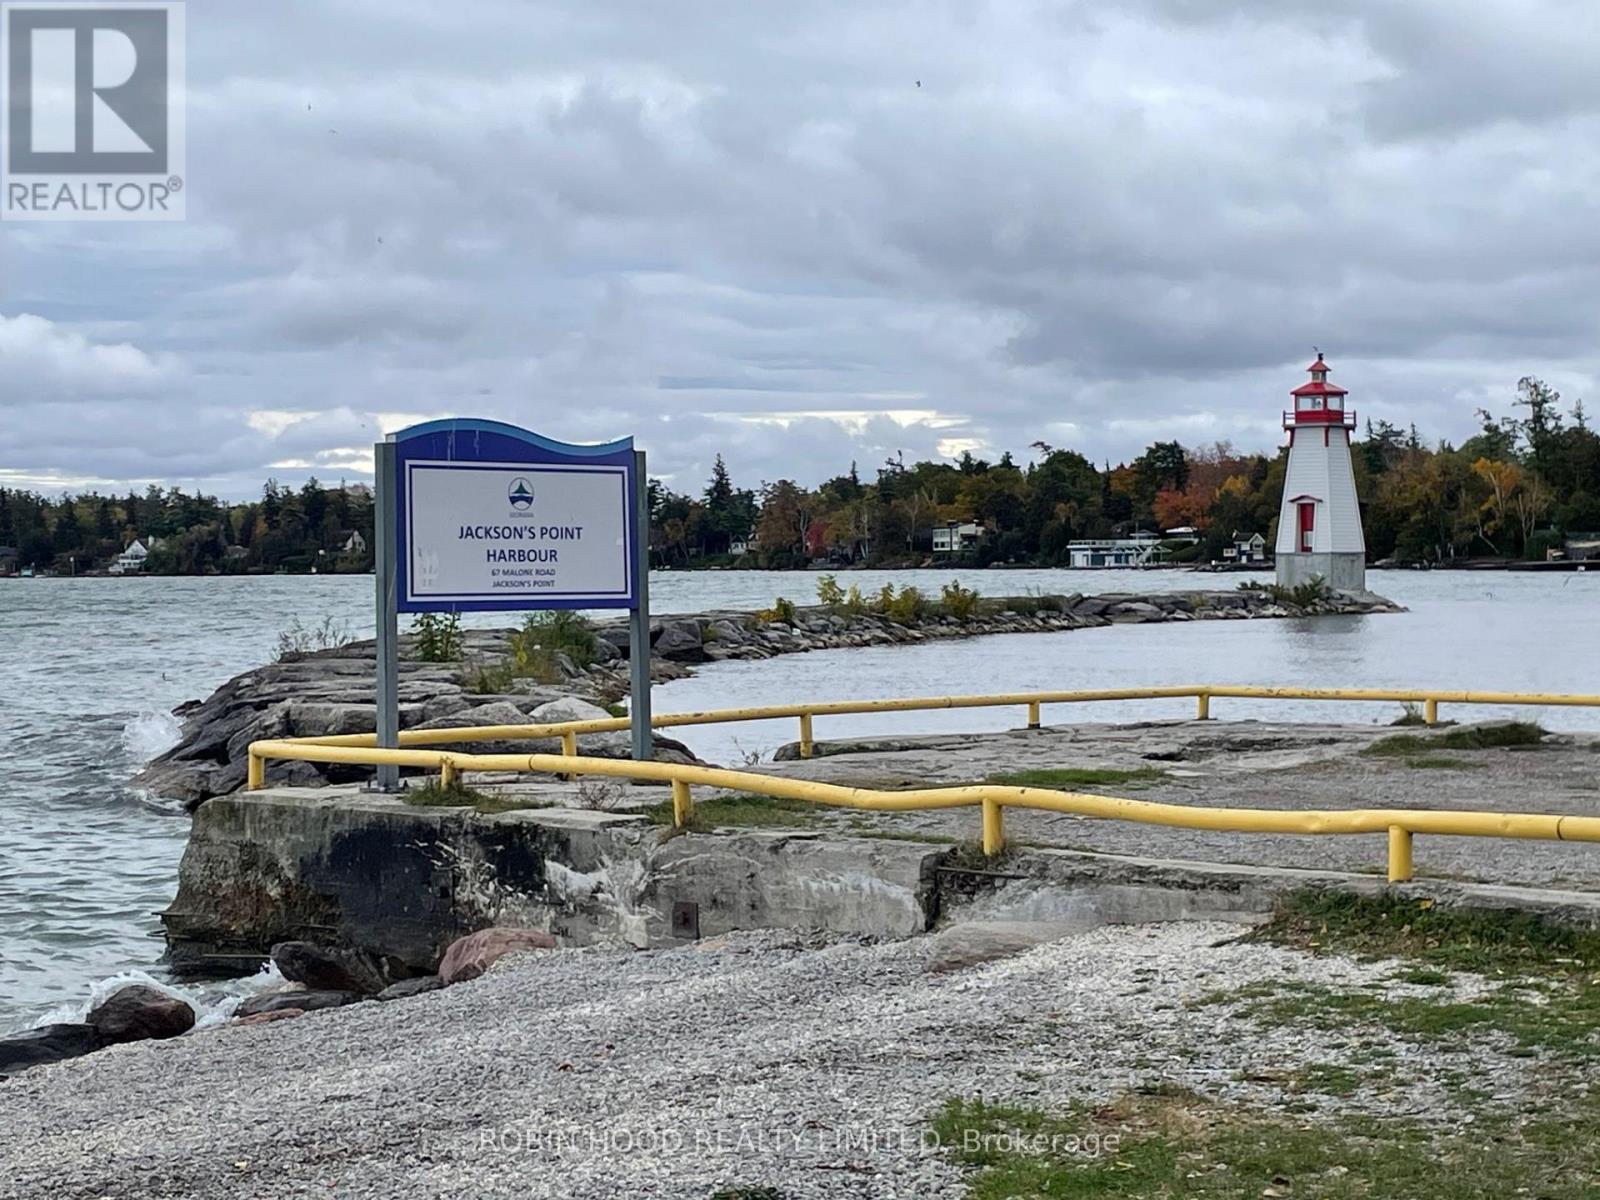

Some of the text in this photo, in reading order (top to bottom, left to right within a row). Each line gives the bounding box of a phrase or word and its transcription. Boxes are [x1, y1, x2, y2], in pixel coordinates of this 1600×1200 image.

[458, 525, 583, 540] JACKSON'S POINT
[486, 549, 558, 563] HARBOUR
[491, 568, 556, 576] 67 MALONE ROAD
[533, 579, 555, 588] POINT
